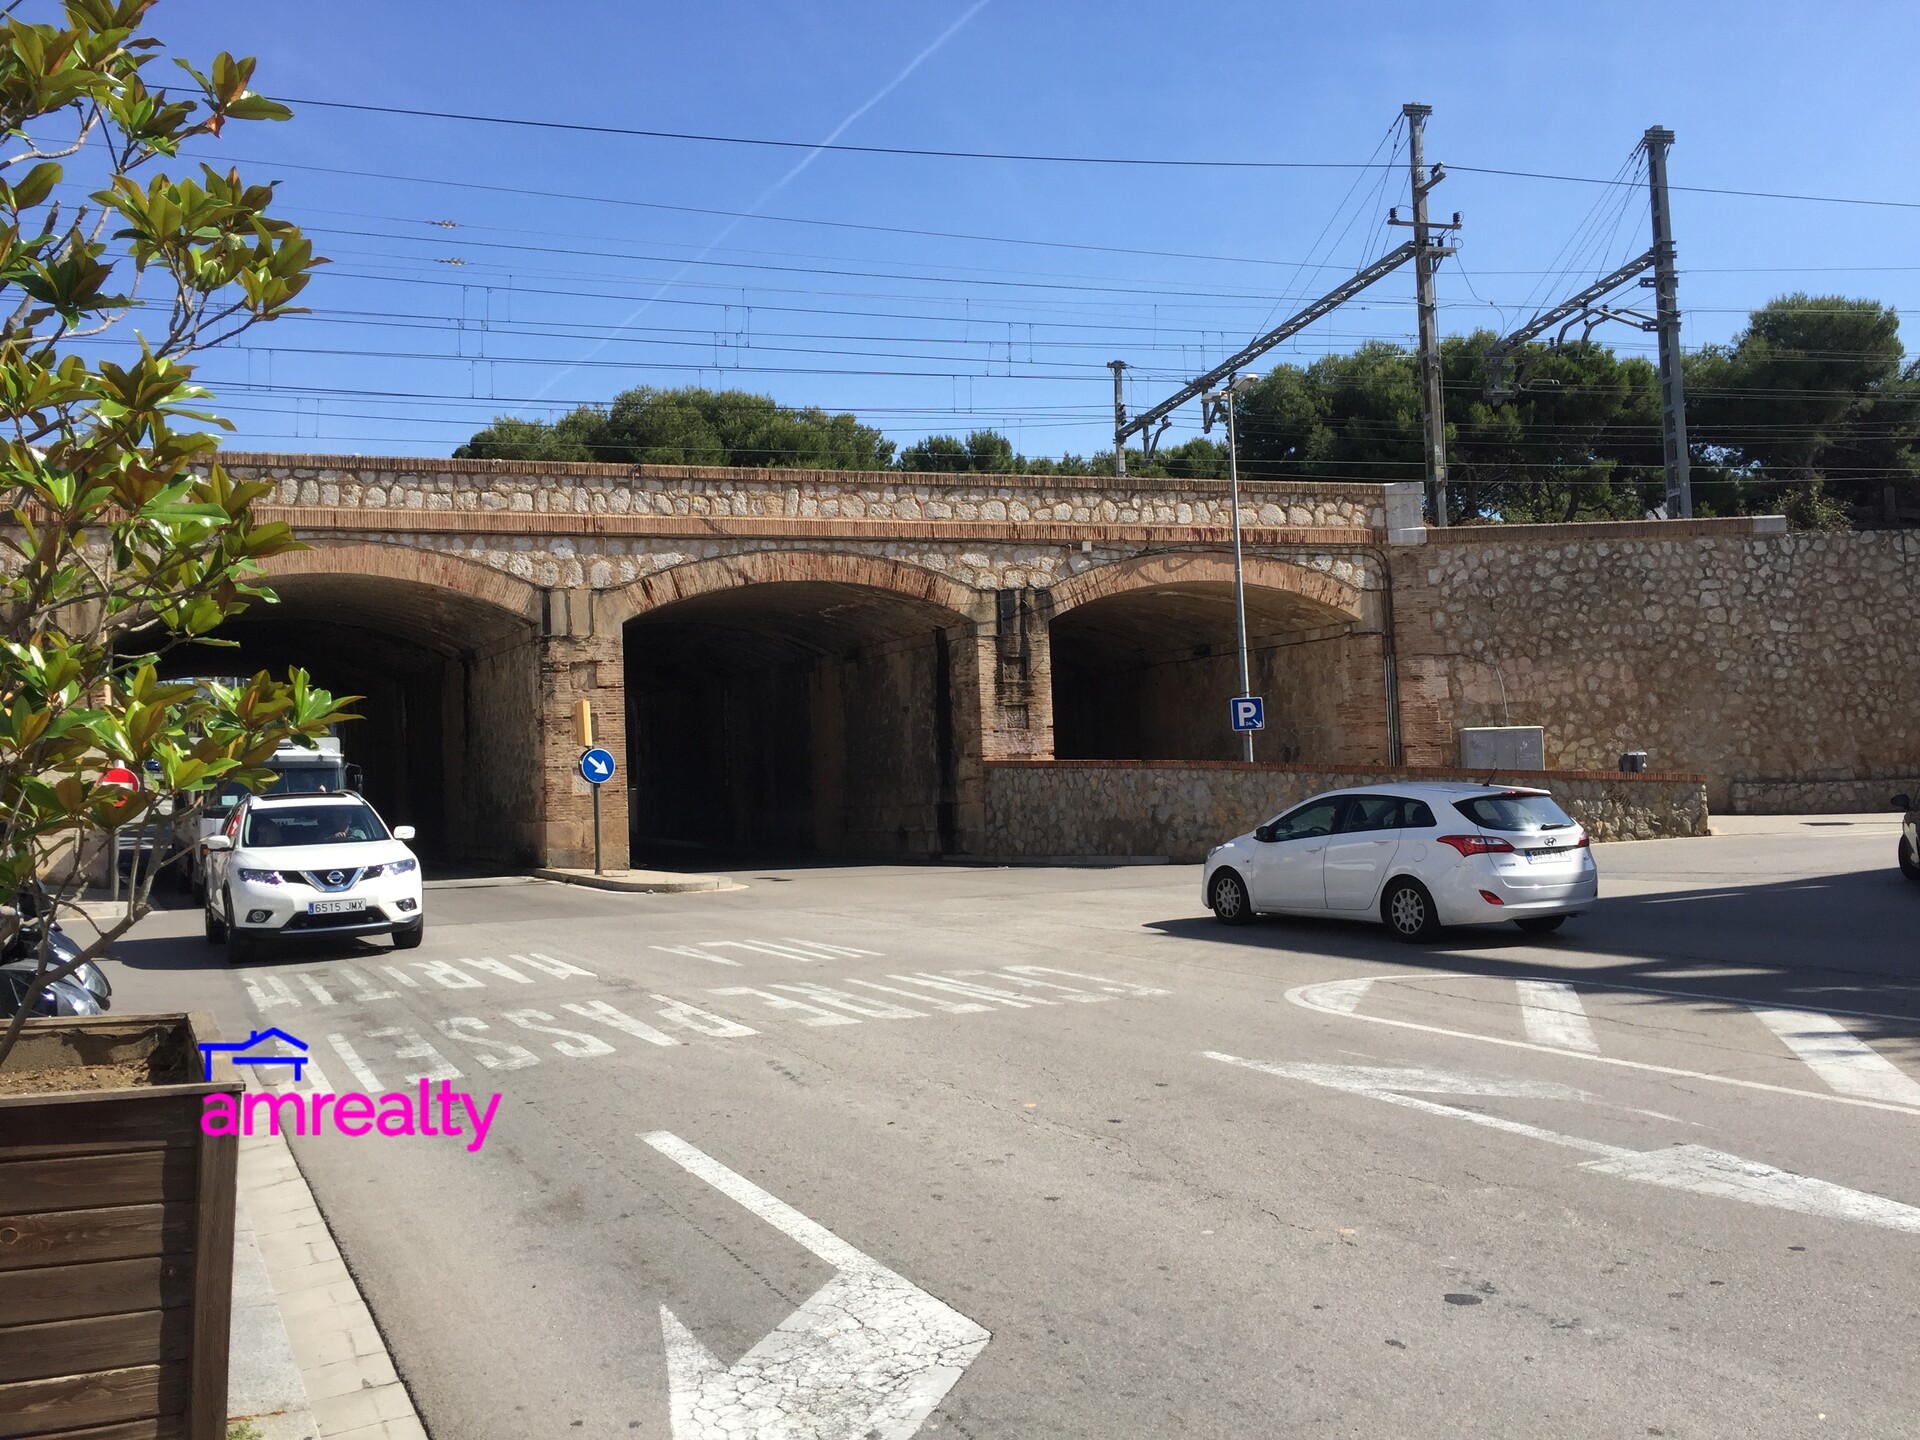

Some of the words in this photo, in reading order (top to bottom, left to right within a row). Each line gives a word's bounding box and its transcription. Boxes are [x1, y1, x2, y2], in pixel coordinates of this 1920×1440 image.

[1237, 701, 1257, 727] P
[315, 902, 341, 913] 6515
[345, 900, 363, 911] JMX
[649, 937, 886, 966] VILA
[707, 966, 1174, 1026] CENTRE
